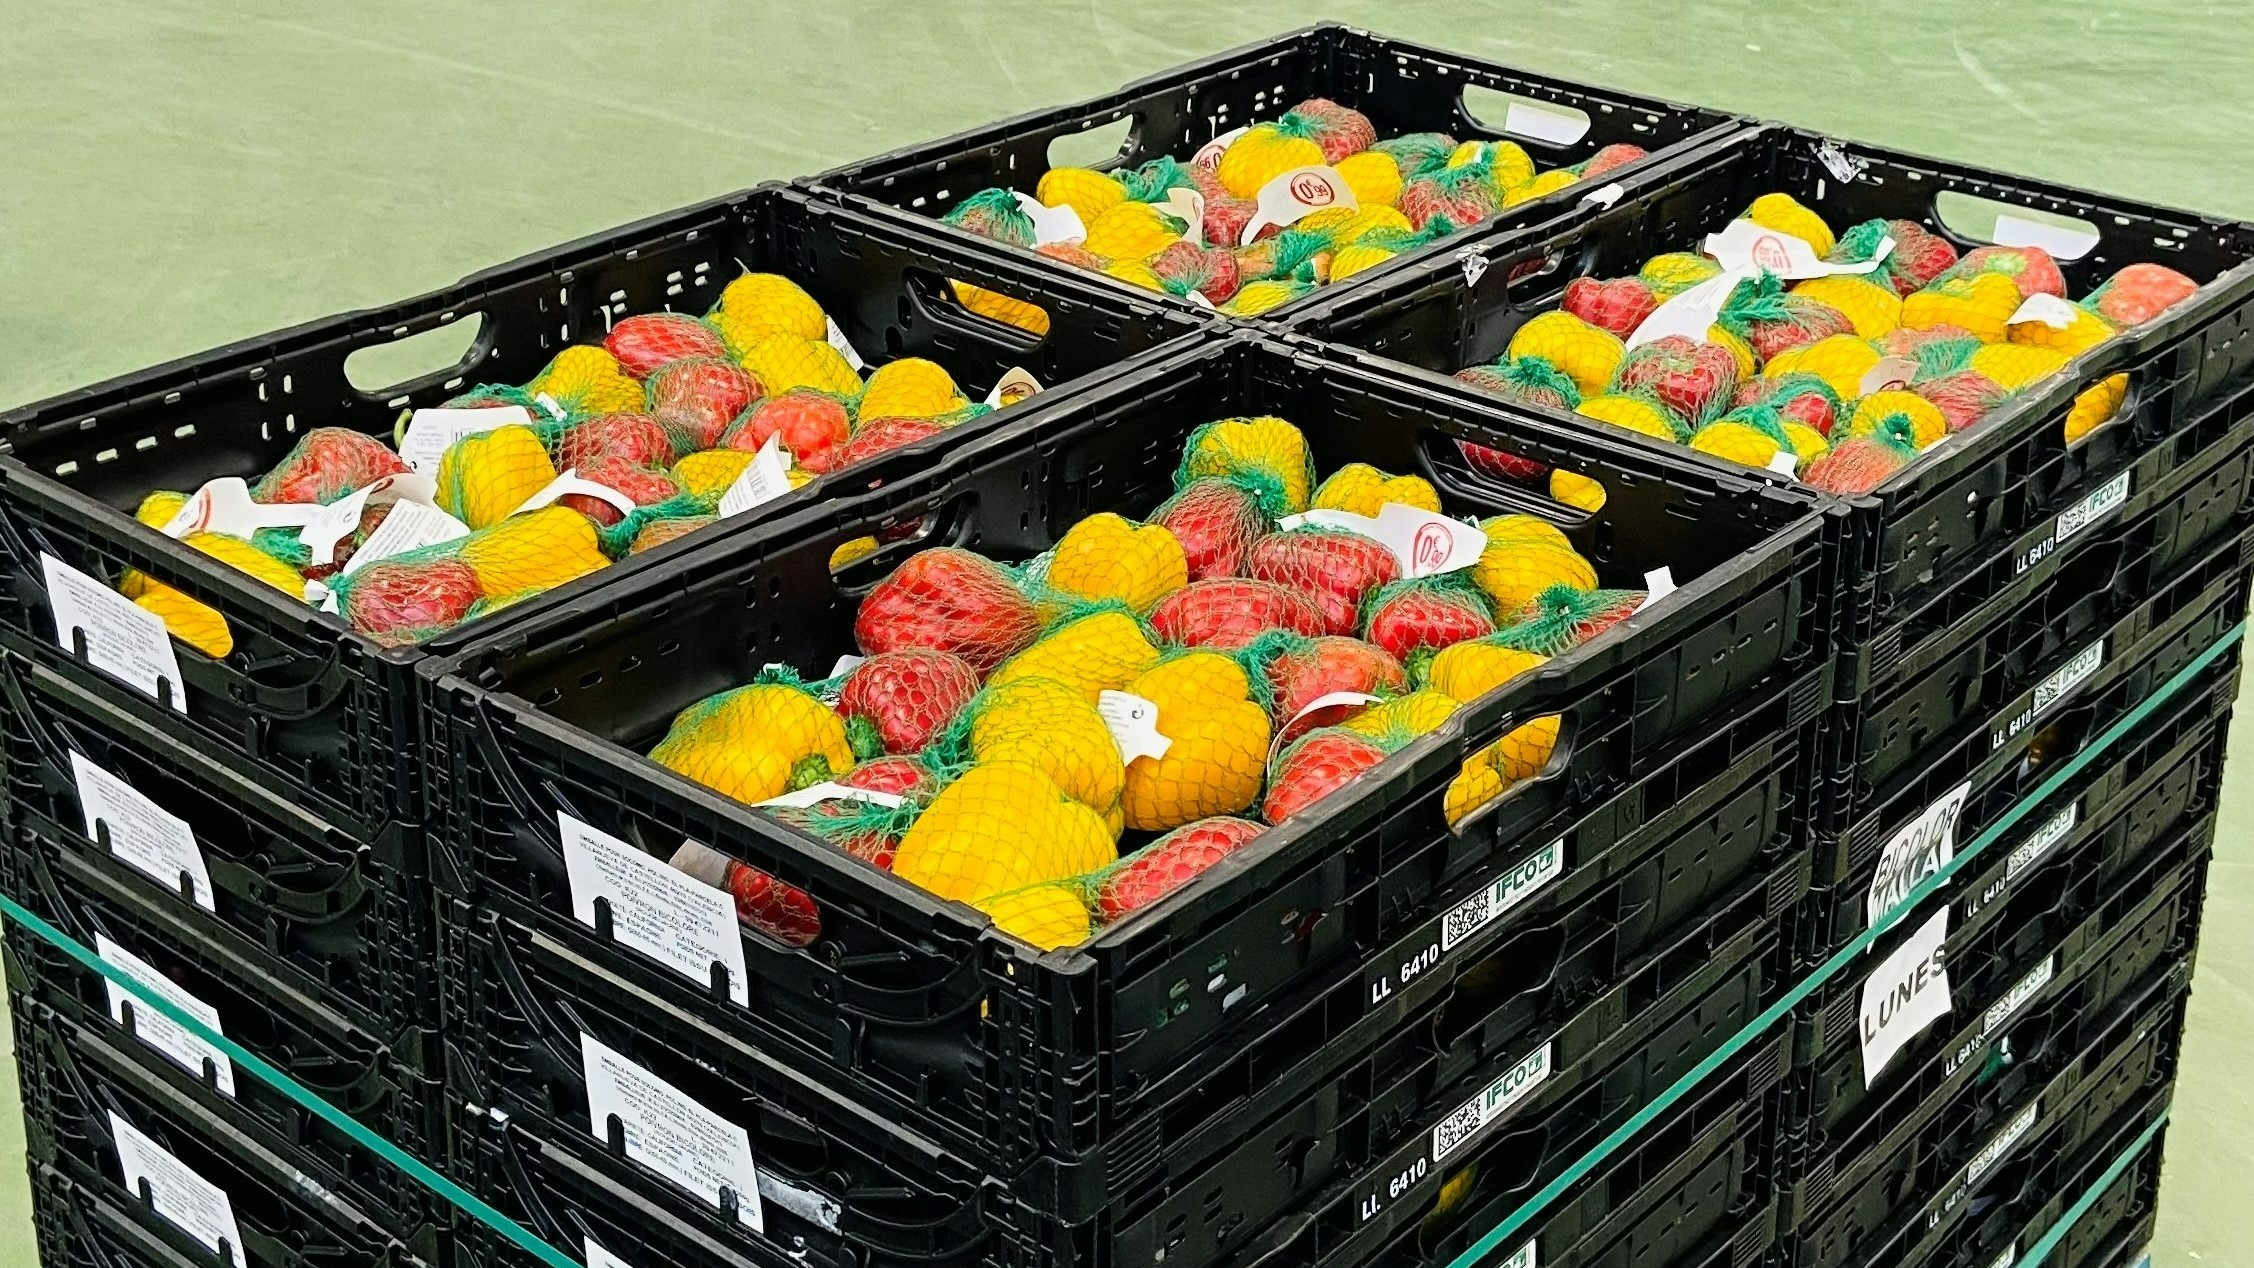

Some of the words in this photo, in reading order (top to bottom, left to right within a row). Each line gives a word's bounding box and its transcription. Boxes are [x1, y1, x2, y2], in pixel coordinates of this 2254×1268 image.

[2089, 484, 2113, 512] IFCO
[2016, 555, 2027, 574] LL
[2029, 537, 2054, 564] 6410
[2063, 653, 2087, 683] IFCO
[1874, 798, 1960, 895] BICOLOR
[1495, 859, 1537, 903] IFCO
[1372, 977, 1391, 1004] LL
[1401, 944, 1439, 982] 6410
[1864, 944, 1946, 1046] LUNES
[1486, 1066, 1526, 1110] IFCO
[1389, 1157, 1427, 1198] 6410
